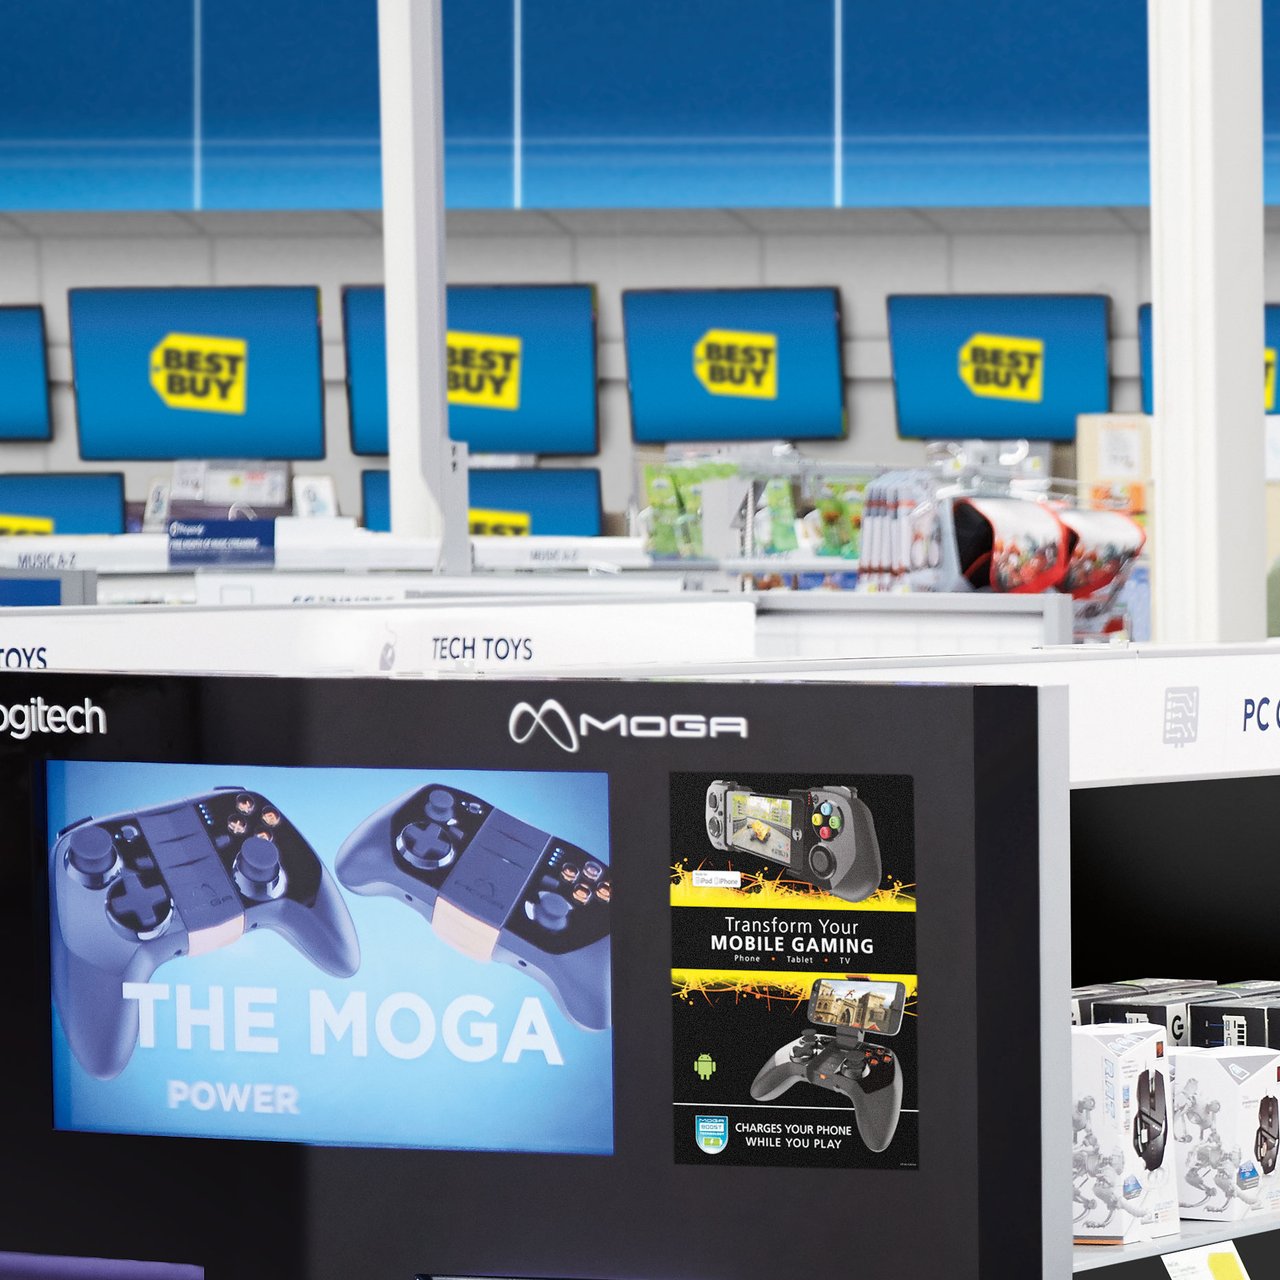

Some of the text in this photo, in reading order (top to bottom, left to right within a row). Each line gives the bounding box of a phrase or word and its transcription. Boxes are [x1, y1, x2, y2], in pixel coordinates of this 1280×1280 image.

[163, 347, 243, 376] BEST
[704, 343, 773, 367] BEST
[970, 345, 1040, 370] BEST
[166, 371, 234, 399] BUY
[707, 364, 766, 388] BUY
[973, 367, 1031, 390] BUY
[17, 553, 54, 570] MUSIC
[432, 637, 533, 661] TECH TOYS
[579, 713, 748, 740] MOGA
[1243, 697, 1270, 732] PC
[719, 877, 738, 886] iPhone
[725, 916, 859, 935] Transform Your
[711, 935, 874, 954] MOBILE GAMING
[734, 954, 851, 965] Phone Tablet TV
[122, 982, 564, 1066] THE MOGA
[167, 1079, 300, 1115] POWER
[735, 1122, 852, 1136] CHARGES YOUR PHONE
[745, 1136, 842, 1149] WHILE YOU PLAY
